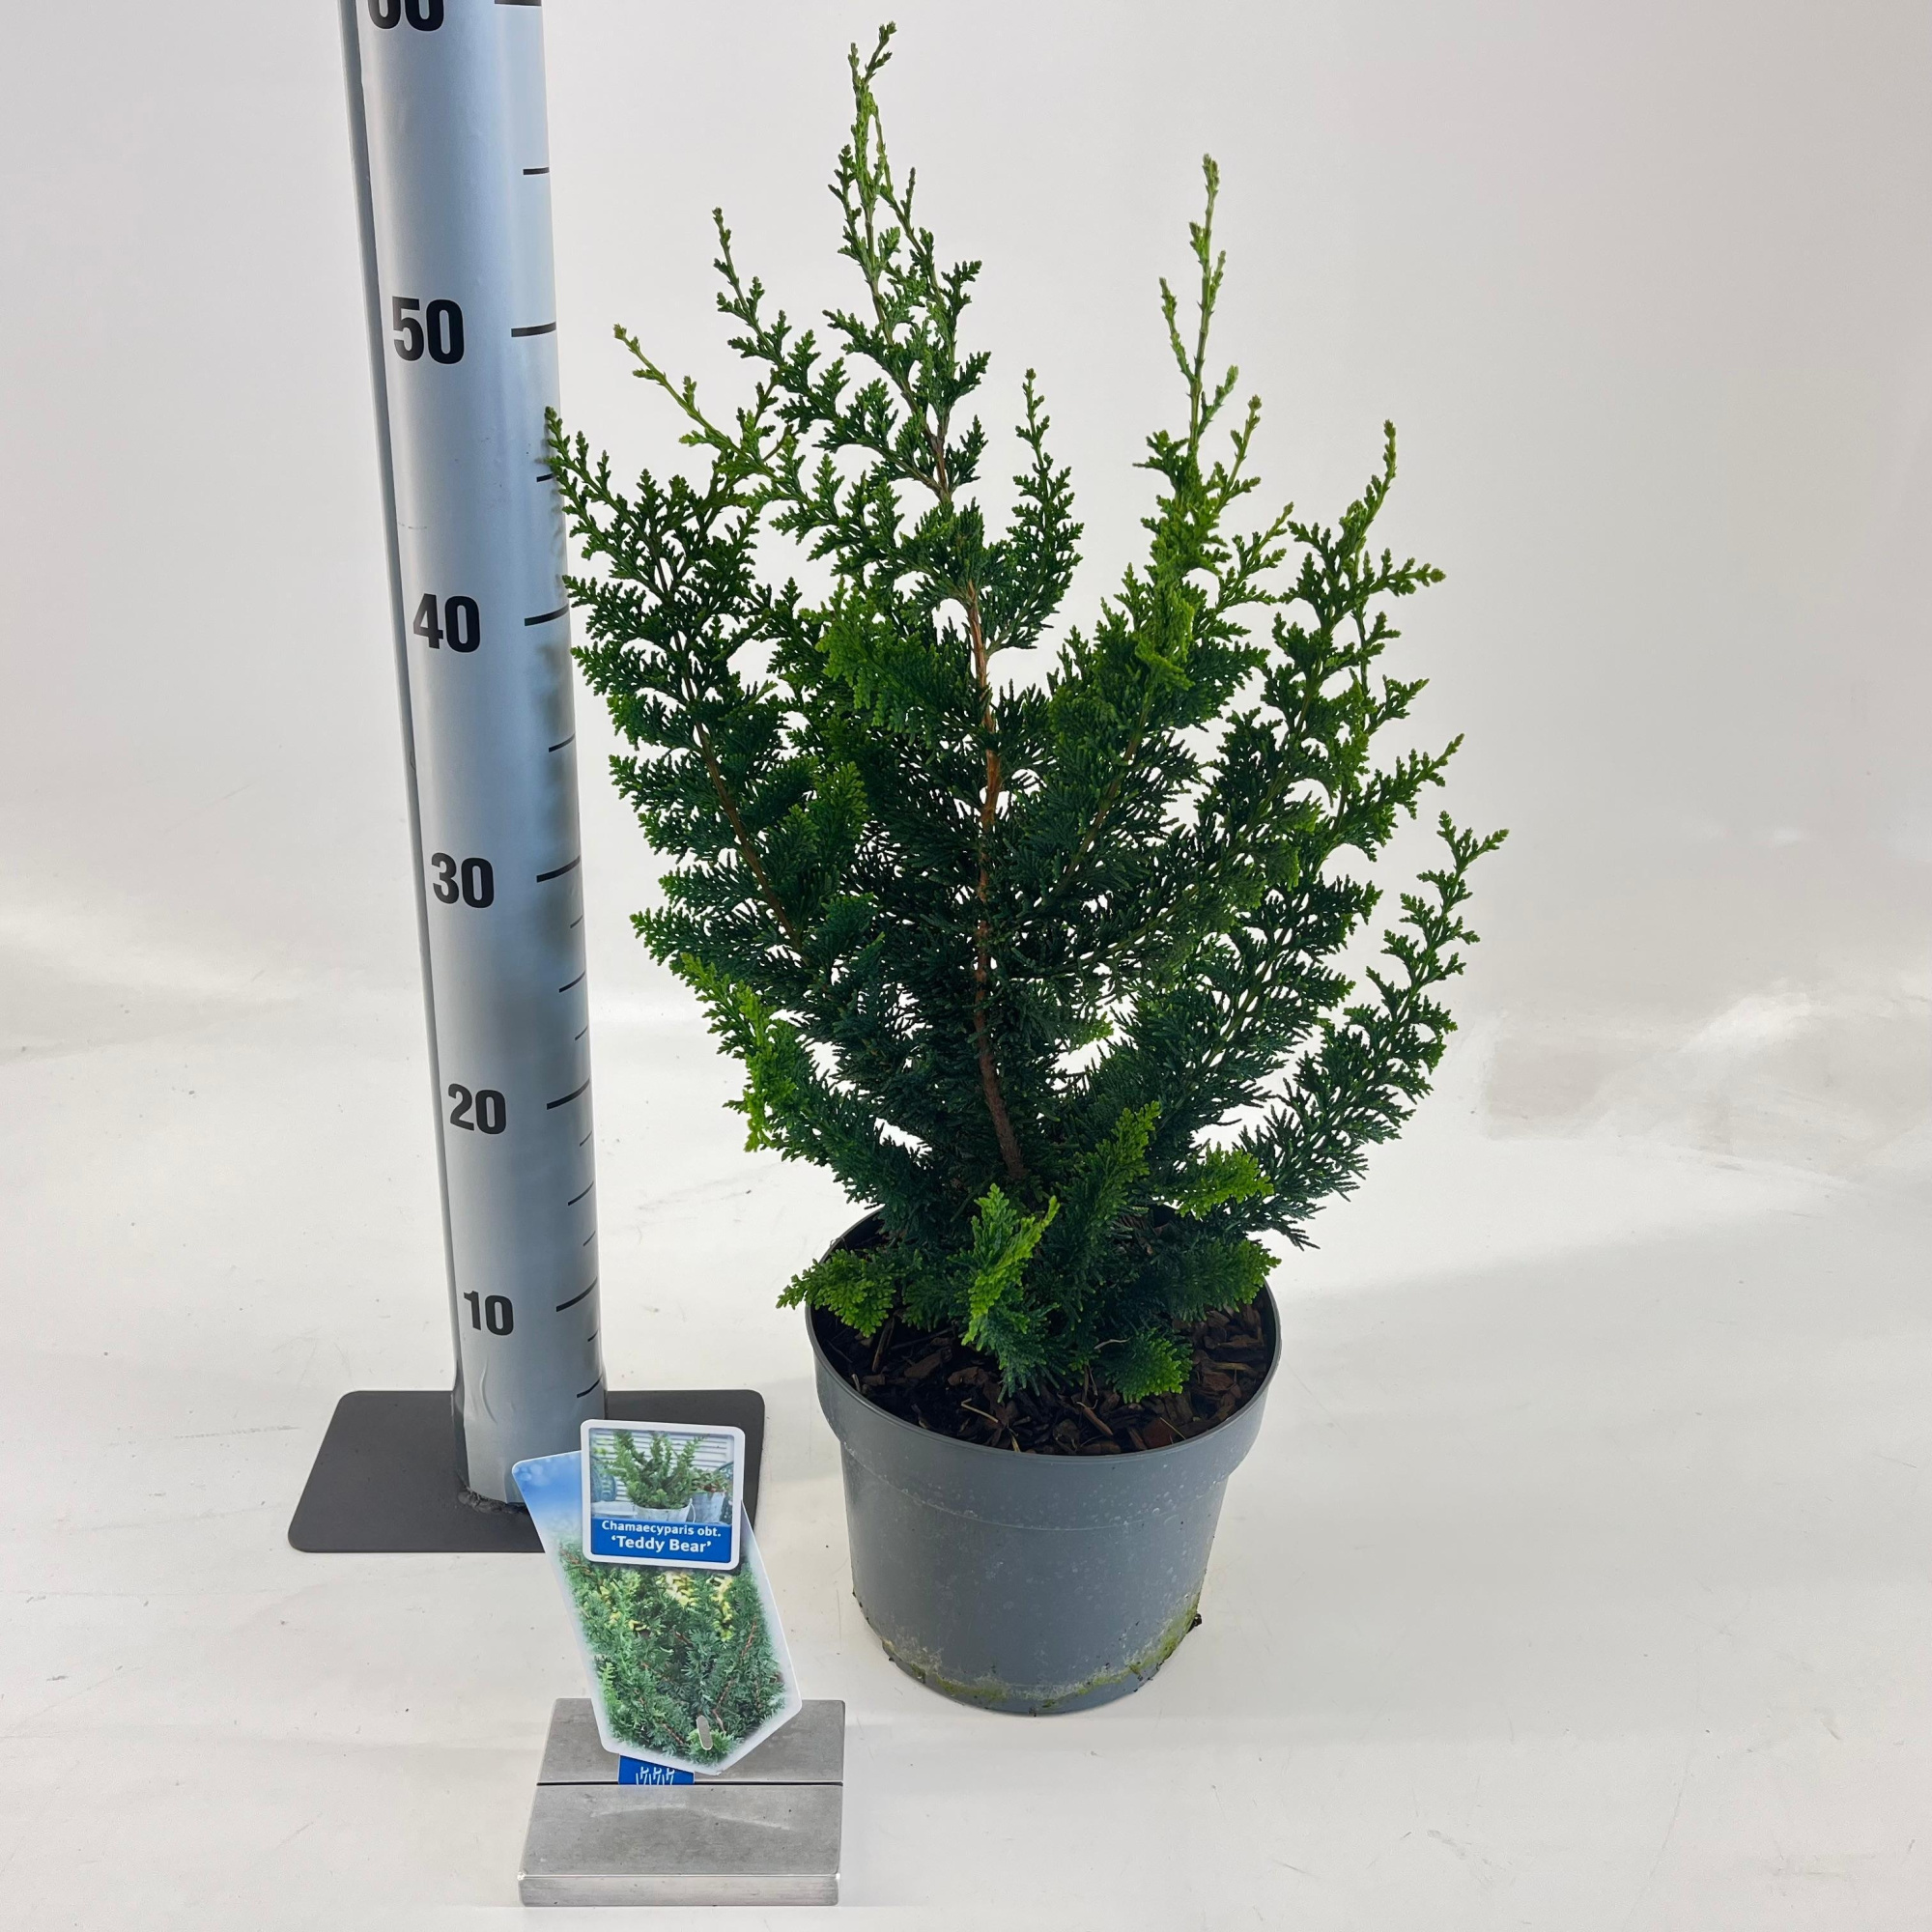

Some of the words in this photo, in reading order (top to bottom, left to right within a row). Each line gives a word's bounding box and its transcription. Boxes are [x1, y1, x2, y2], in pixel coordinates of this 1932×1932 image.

[392, 296, 465, 364] 50
[412, 593, 481, 653] 40
[431, 852, 495, 909] 30
[447, 1083, 507, 1135] 20
[463, 1290, 514, 1336] 10
[601, 1520, 695, 1536] Chamaecyparis
[696, 1526, 722, 1537] obt.
[611, 1535, 665, 1552] ‘Teddy
[668, 1538, 712, 1552] Bear’
